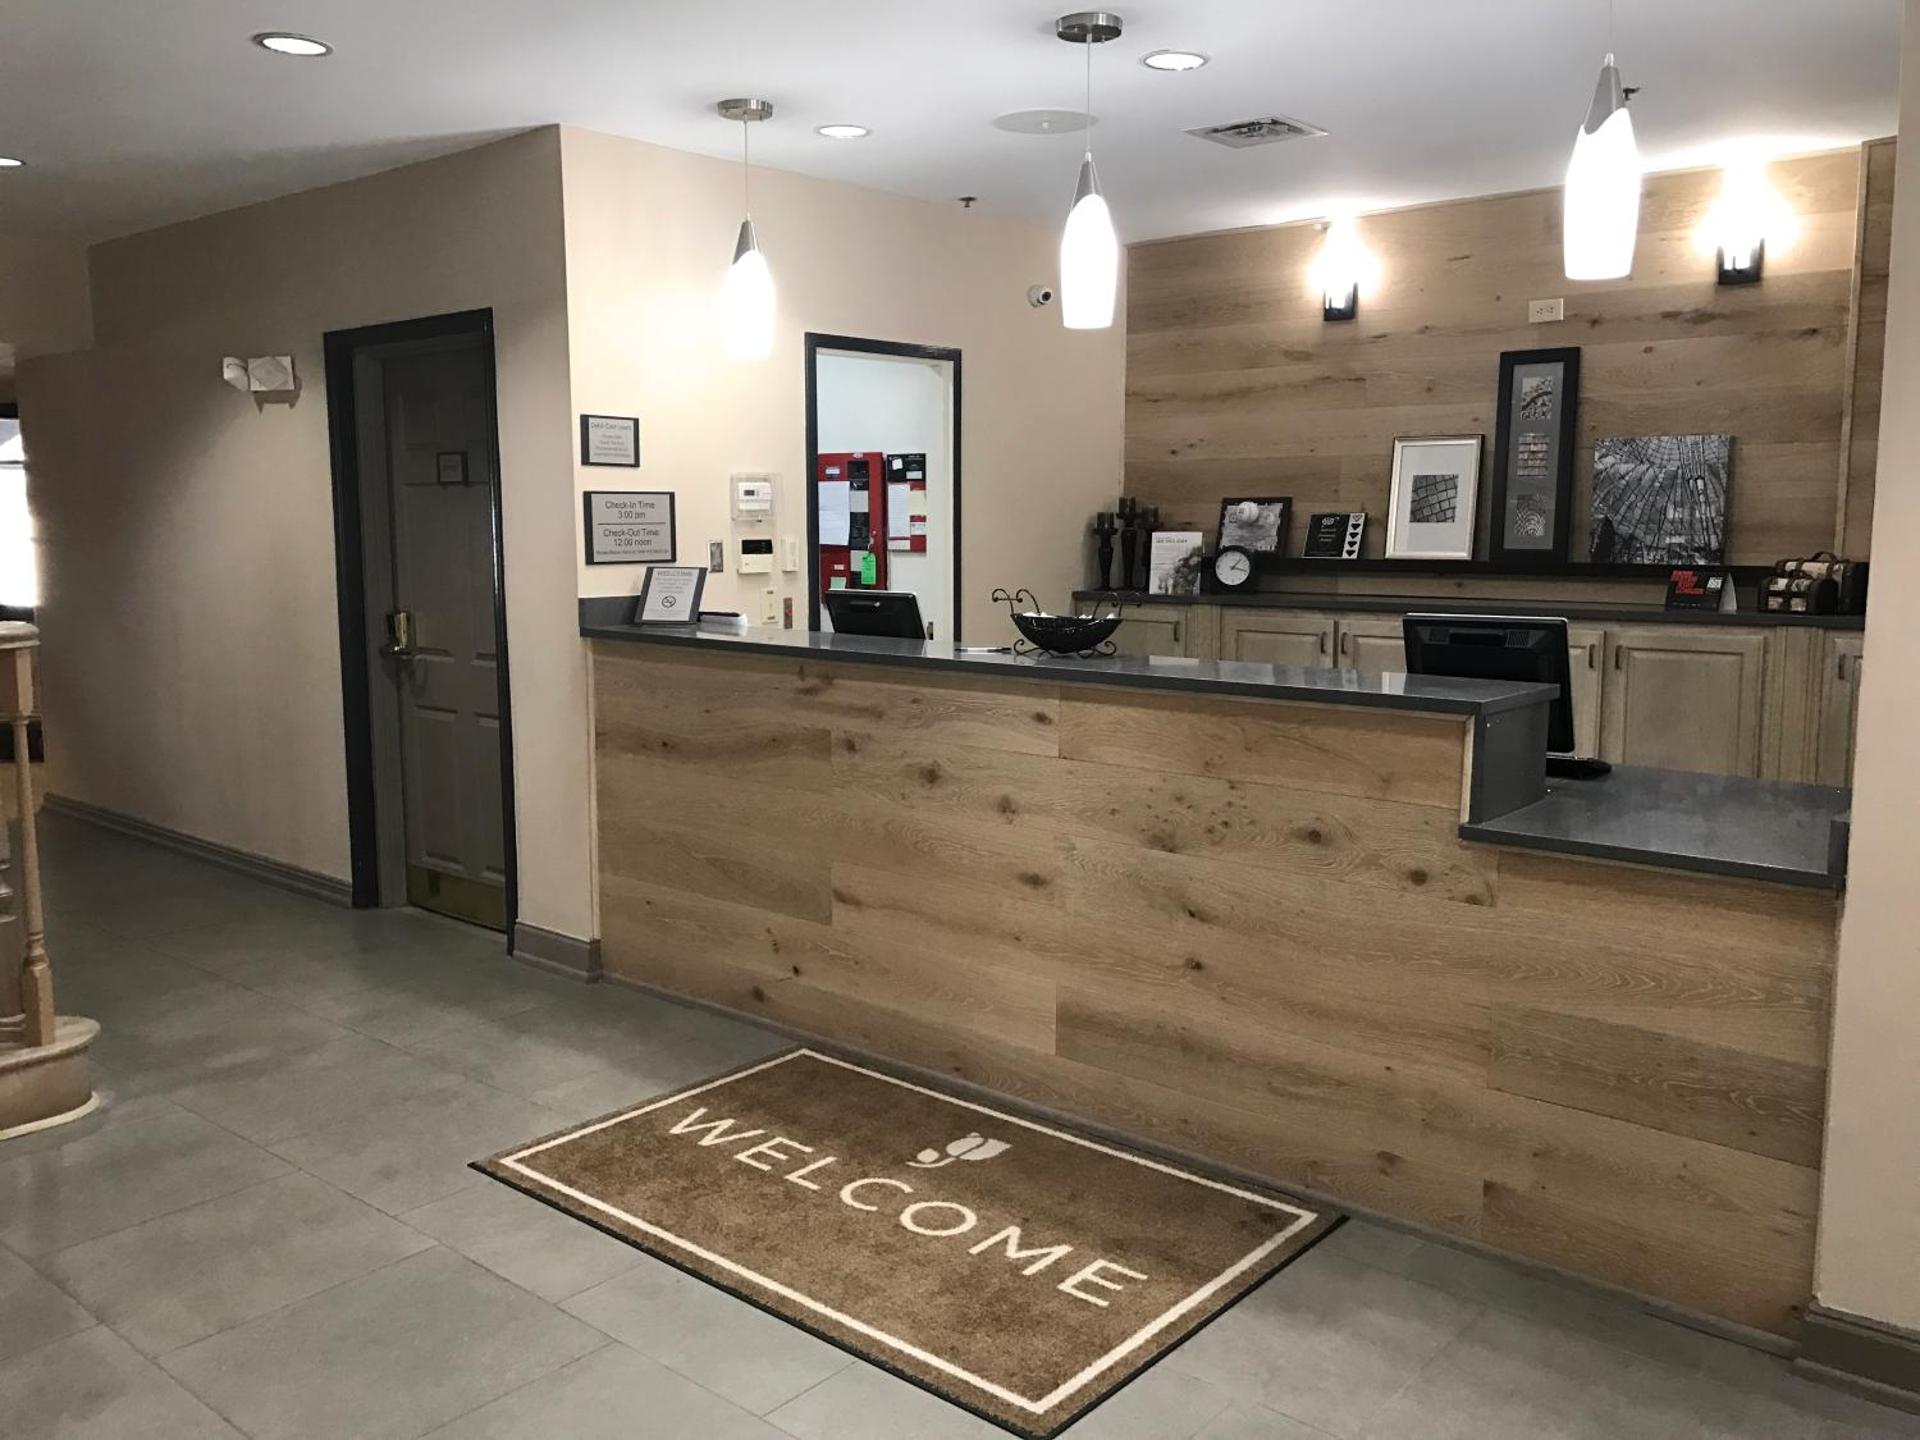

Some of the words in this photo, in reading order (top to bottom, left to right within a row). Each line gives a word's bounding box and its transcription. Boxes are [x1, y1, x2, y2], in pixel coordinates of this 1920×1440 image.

[604, 500, 637, 510] Check-In
[638, 501, 656, 510] Time
[634, 511, 646, 520] pm
[603, 528, 640, 537] Check-Out
[641, 528, 660, 537] Time
[669, 1107, 1149, 1307] WELCOME
